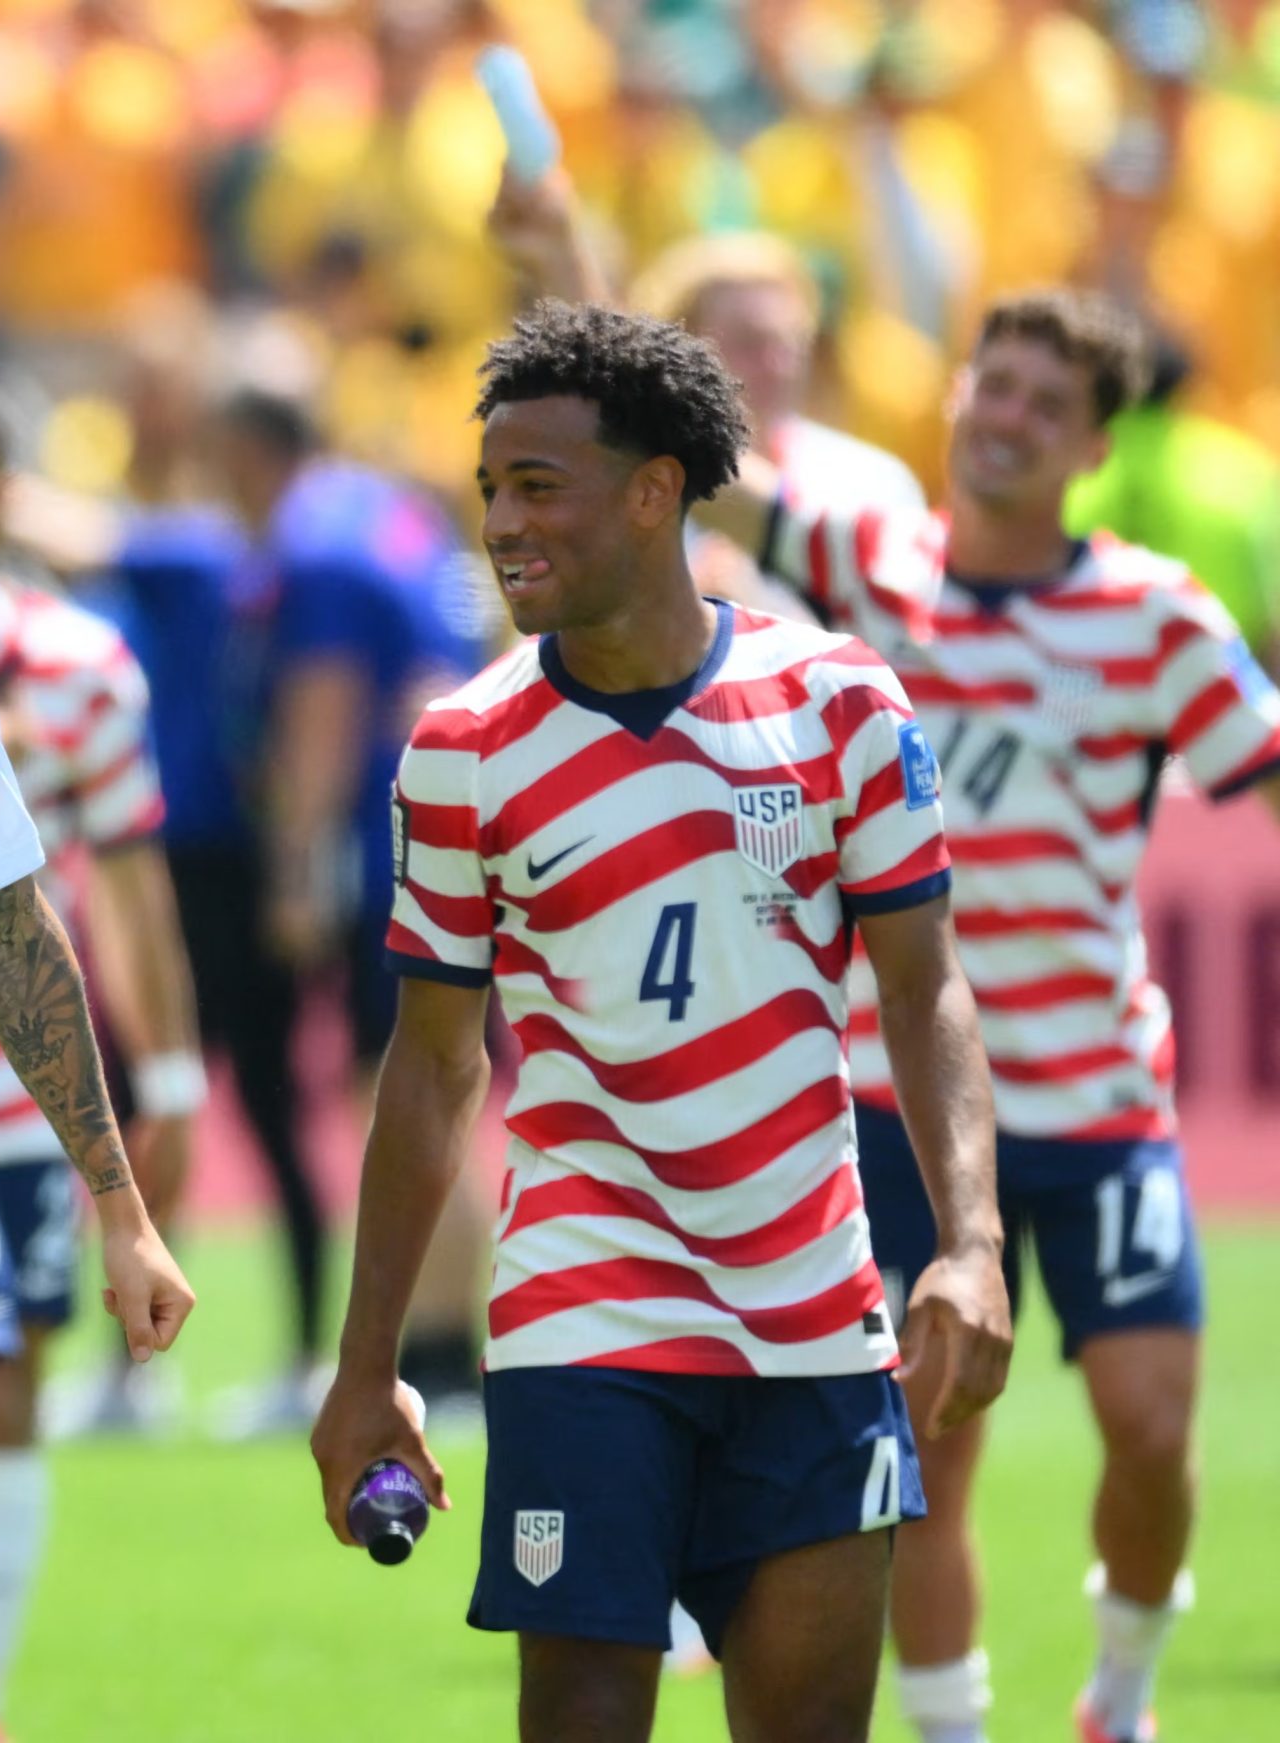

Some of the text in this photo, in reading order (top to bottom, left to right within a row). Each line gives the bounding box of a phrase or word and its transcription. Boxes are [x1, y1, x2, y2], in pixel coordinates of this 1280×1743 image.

[738, 790, 797, 824] USA
[639, 902, 698, 1022] 4
[1094, 1168, 1182, 1270] 14
[520, 1515, 560, 1543] USA
